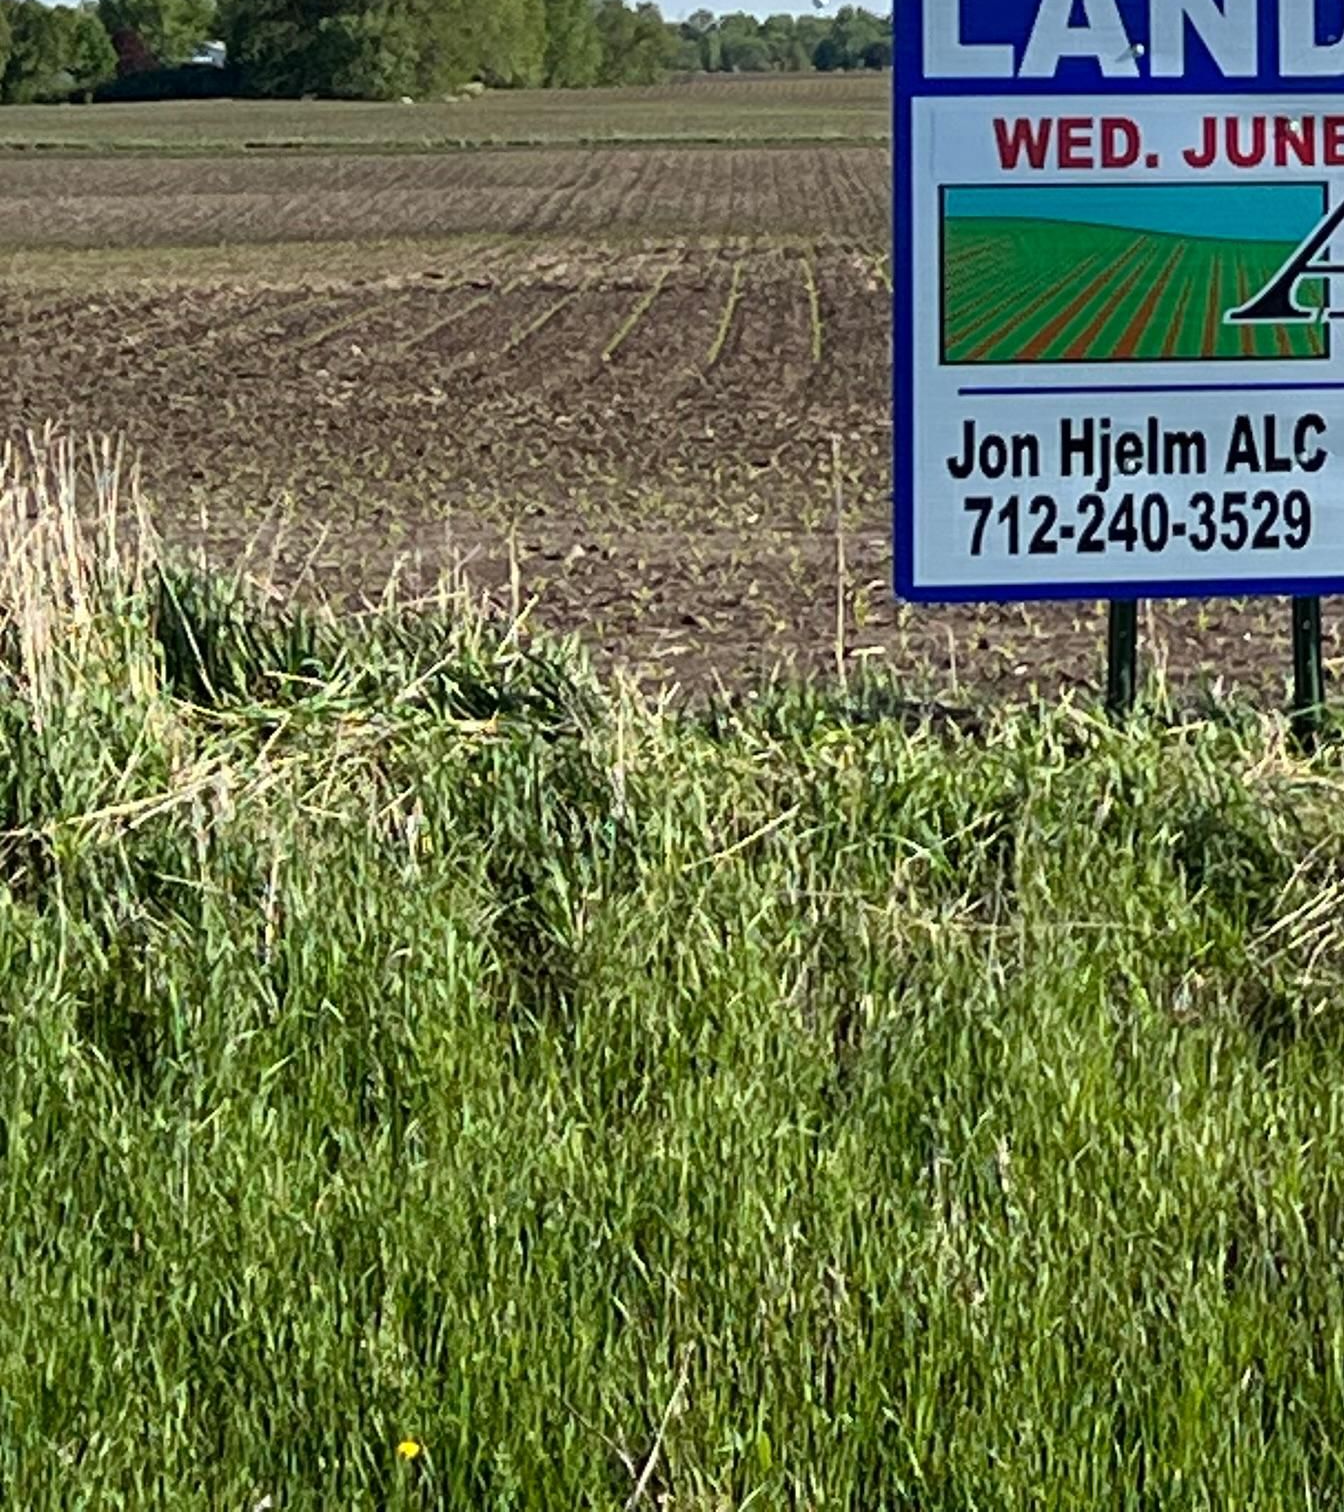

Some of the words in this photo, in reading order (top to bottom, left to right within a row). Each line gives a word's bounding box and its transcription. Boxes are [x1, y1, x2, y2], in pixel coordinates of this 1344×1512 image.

[993, 116, 1159, 170] WED.
[946, 419, 1039, 480] Jon
[1059, 415, 1207, 491] Hjelm
[1225, 412, 1327, 474] ALC
[963, 489, 1312, 557] 712-240-3529
